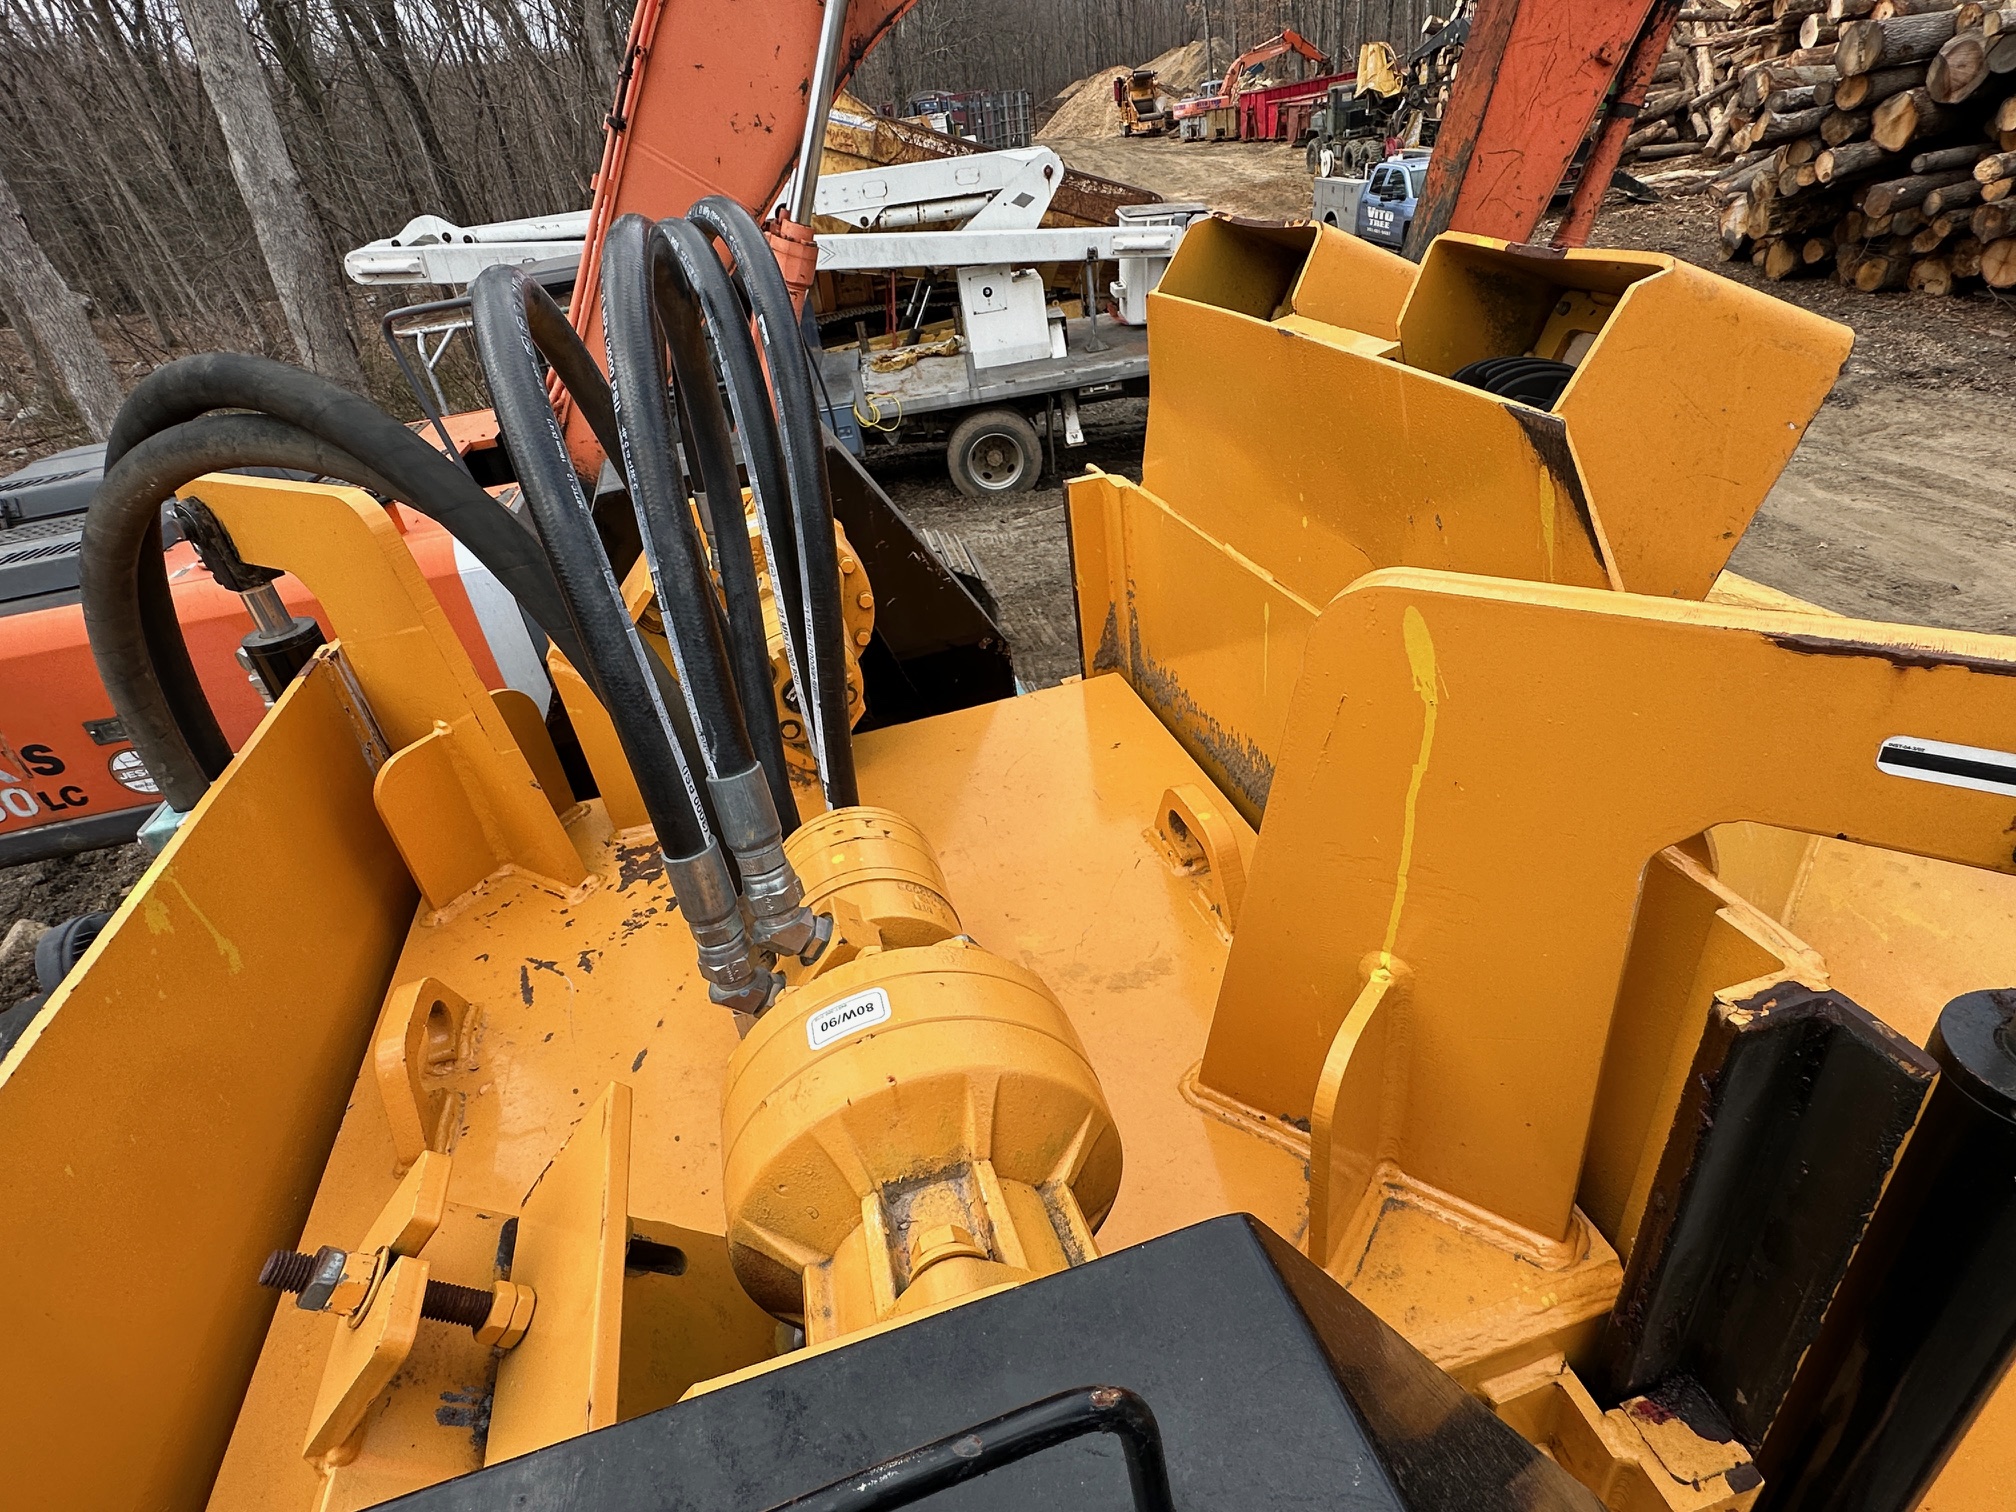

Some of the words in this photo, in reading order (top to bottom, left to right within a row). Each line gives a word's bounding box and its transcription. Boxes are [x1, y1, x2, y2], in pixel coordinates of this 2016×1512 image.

[1367, 206, 1394, 221] VITO
[1369, 218, 1390, 229] TREE
[611, 379, 621, 413] PSI)
[682, 766, 695, 794] PSI)
[694, 796, 709, 832] (3000
[821, 1002, 874, 1032] 80W/90
